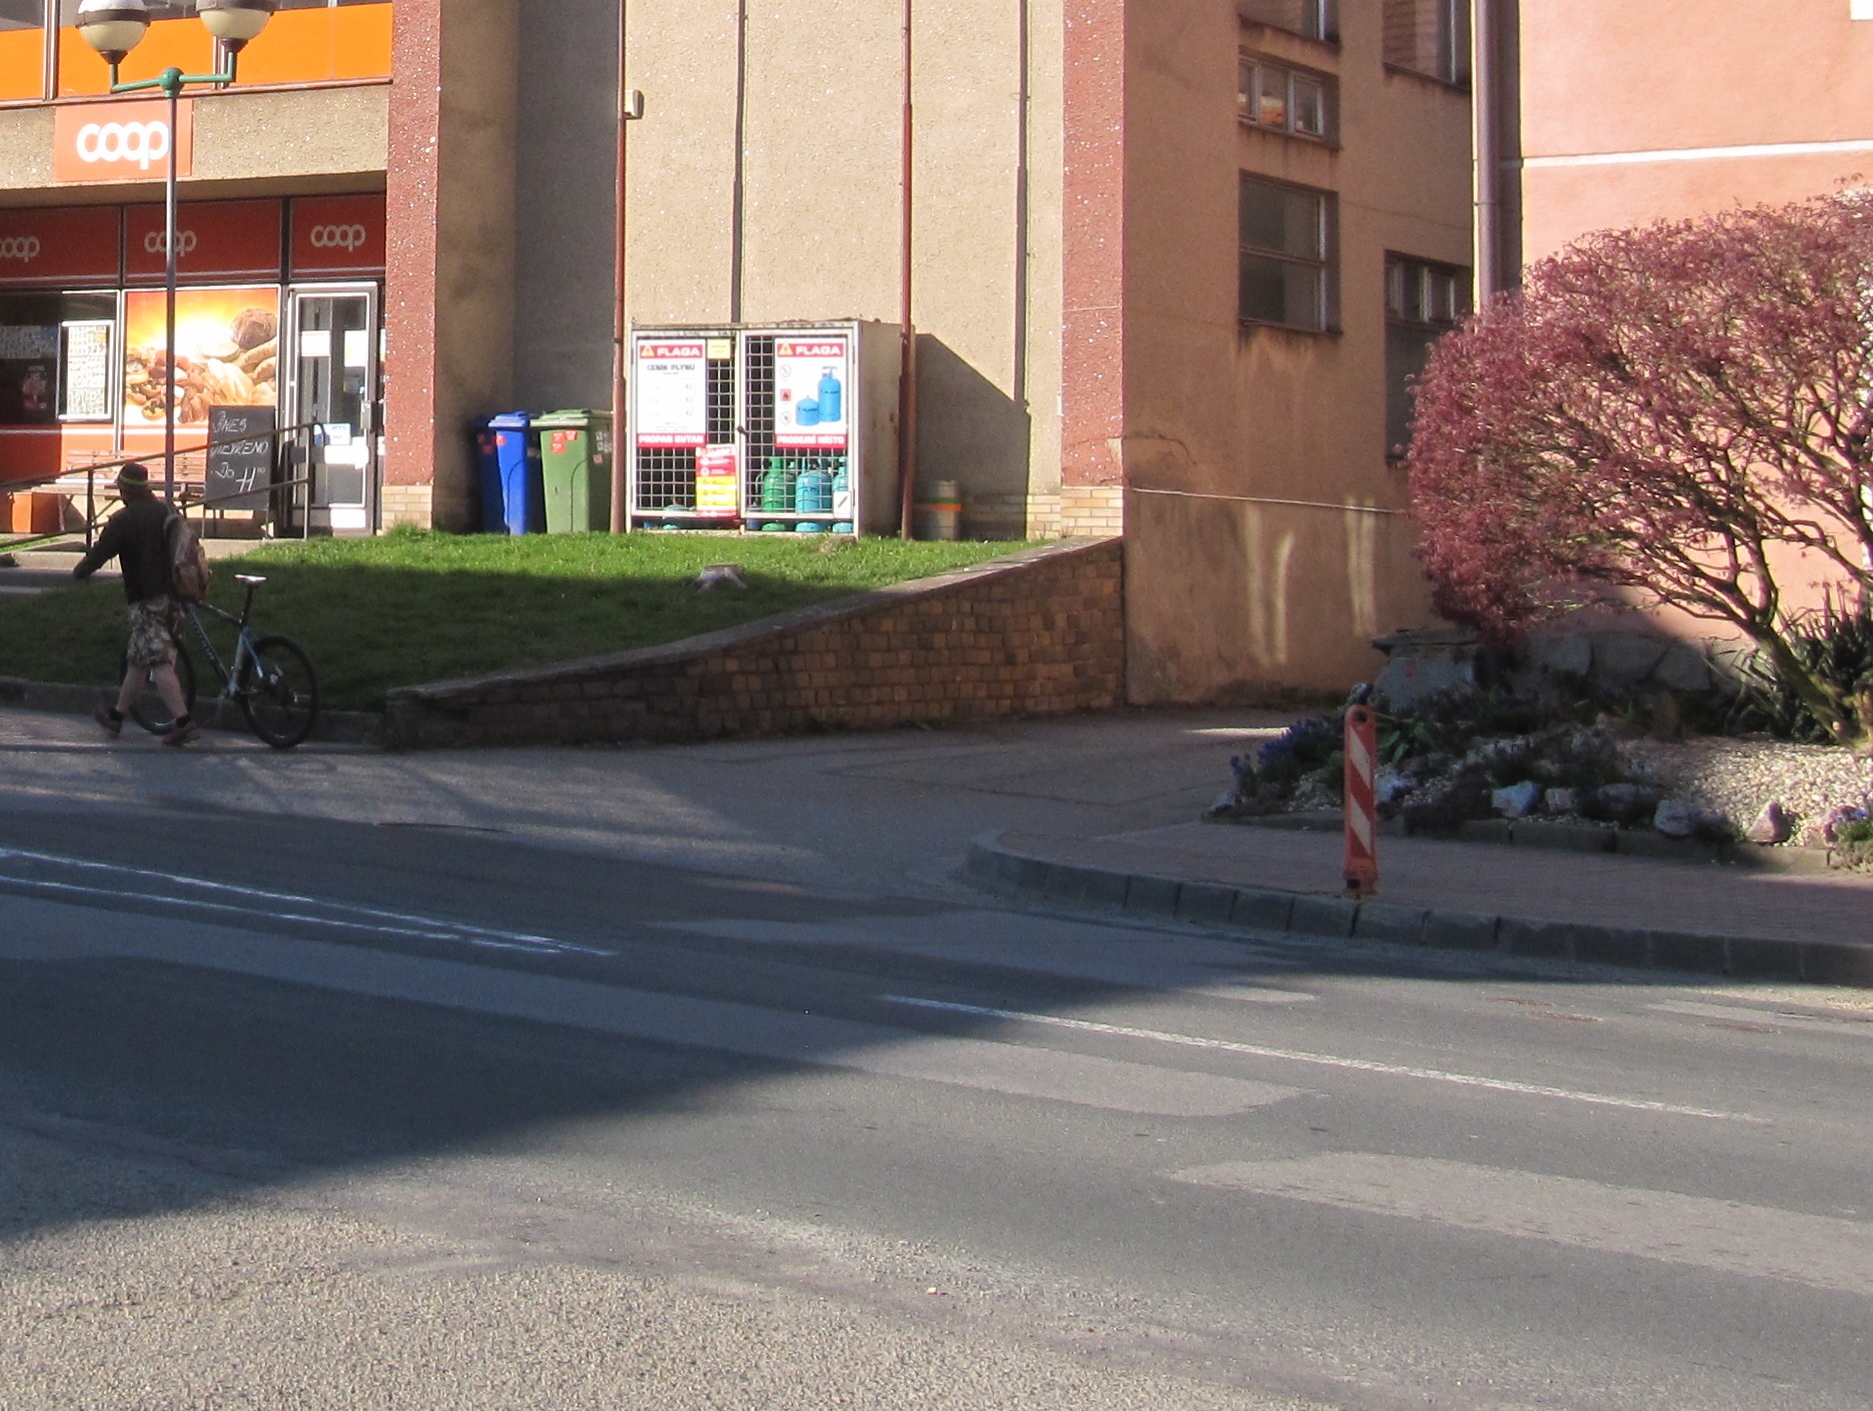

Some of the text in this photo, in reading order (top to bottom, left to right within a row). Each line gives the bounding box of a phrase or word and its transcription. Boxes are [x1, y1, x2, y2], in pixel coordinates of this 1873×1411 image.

[76, 121, 171, 170] coop
[144, 229, 197, 258] coop
[310, 224, 366, 252] coop
[656, 347, 701, 357] FLAGA
[795, 345, 841, 356] FLAGA
